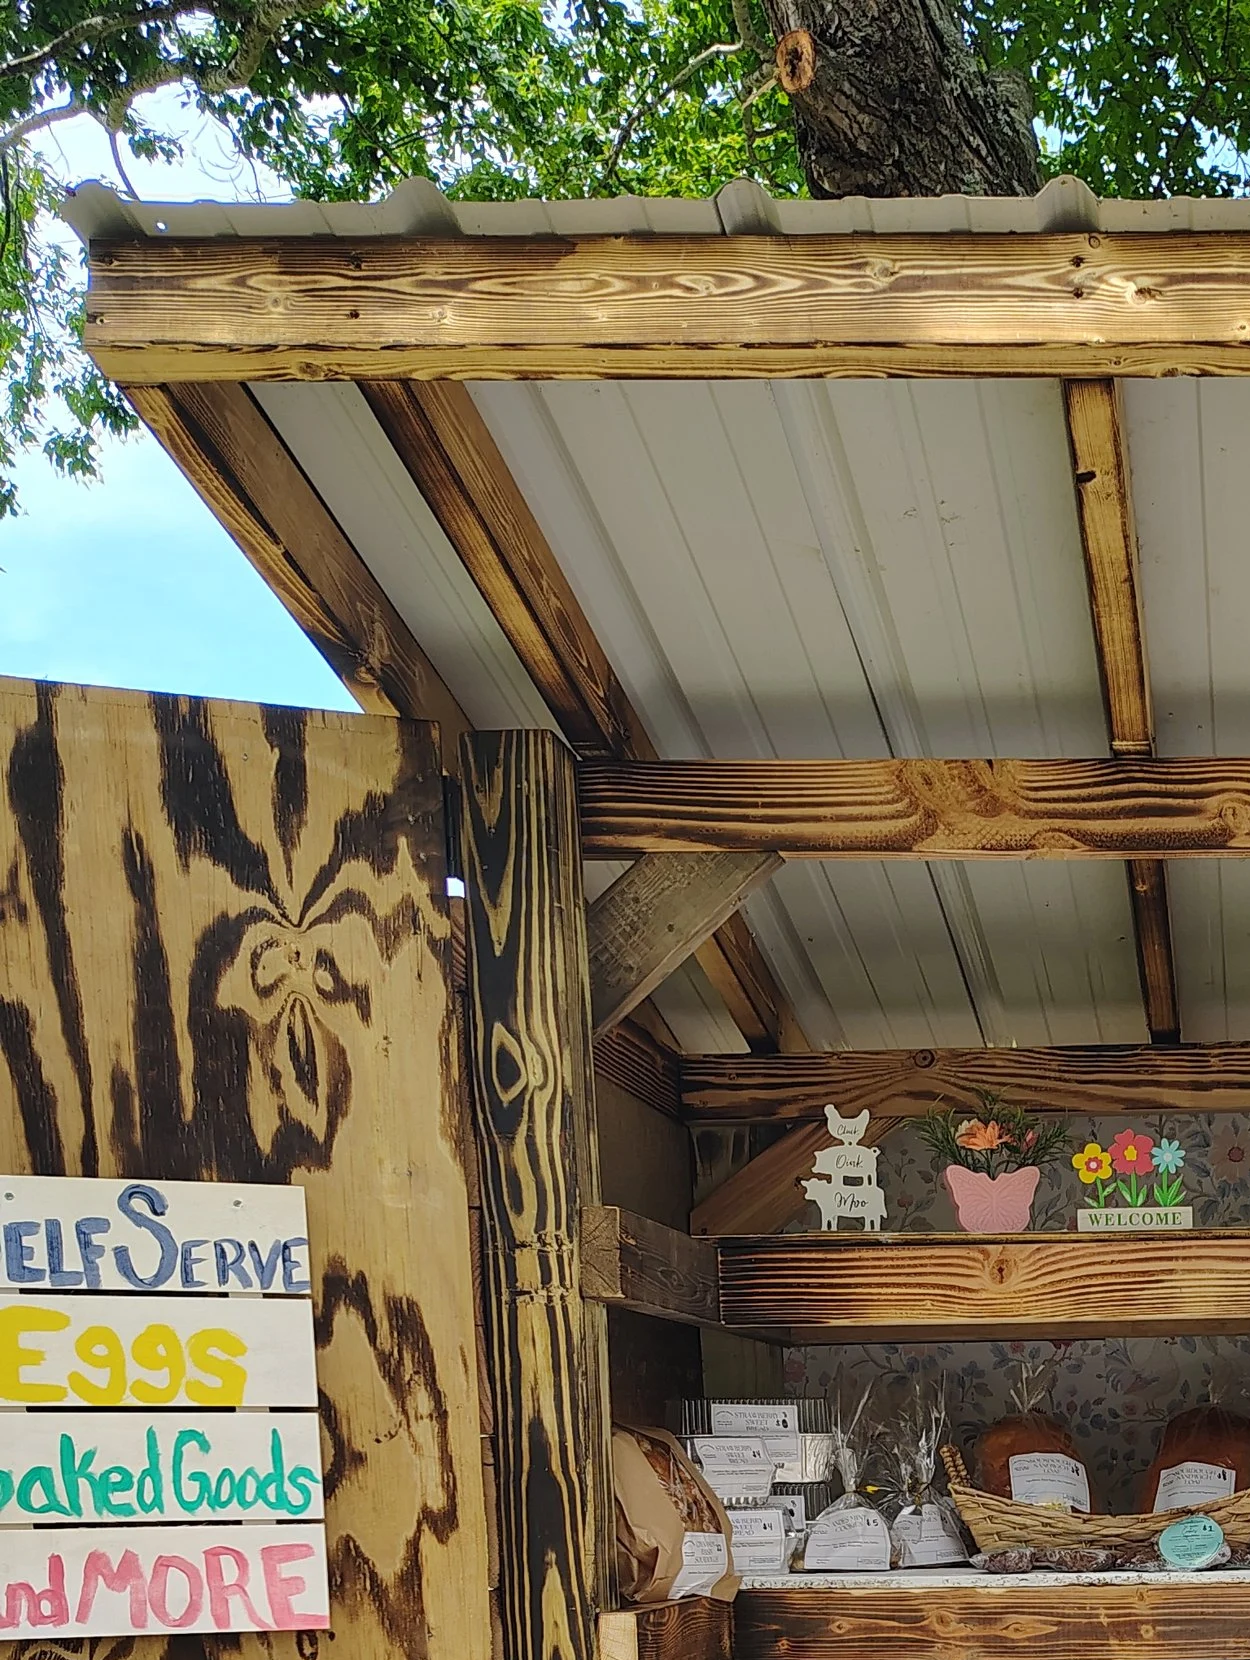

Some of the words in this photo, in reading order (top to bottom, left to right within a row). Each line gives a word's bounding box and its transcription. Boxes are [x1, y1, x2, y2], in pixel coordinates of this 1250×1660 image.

[834, 1192, 869, 1212] Moo
[1088, 1212, 1182, 1226] WELCOME
[0, 1217, 111, 1288] ELF
[173, 1429, 321, 1515] Goods
[0, 1553, 69, 1628] nd
[75, 1543, 331, 1630] MORE
